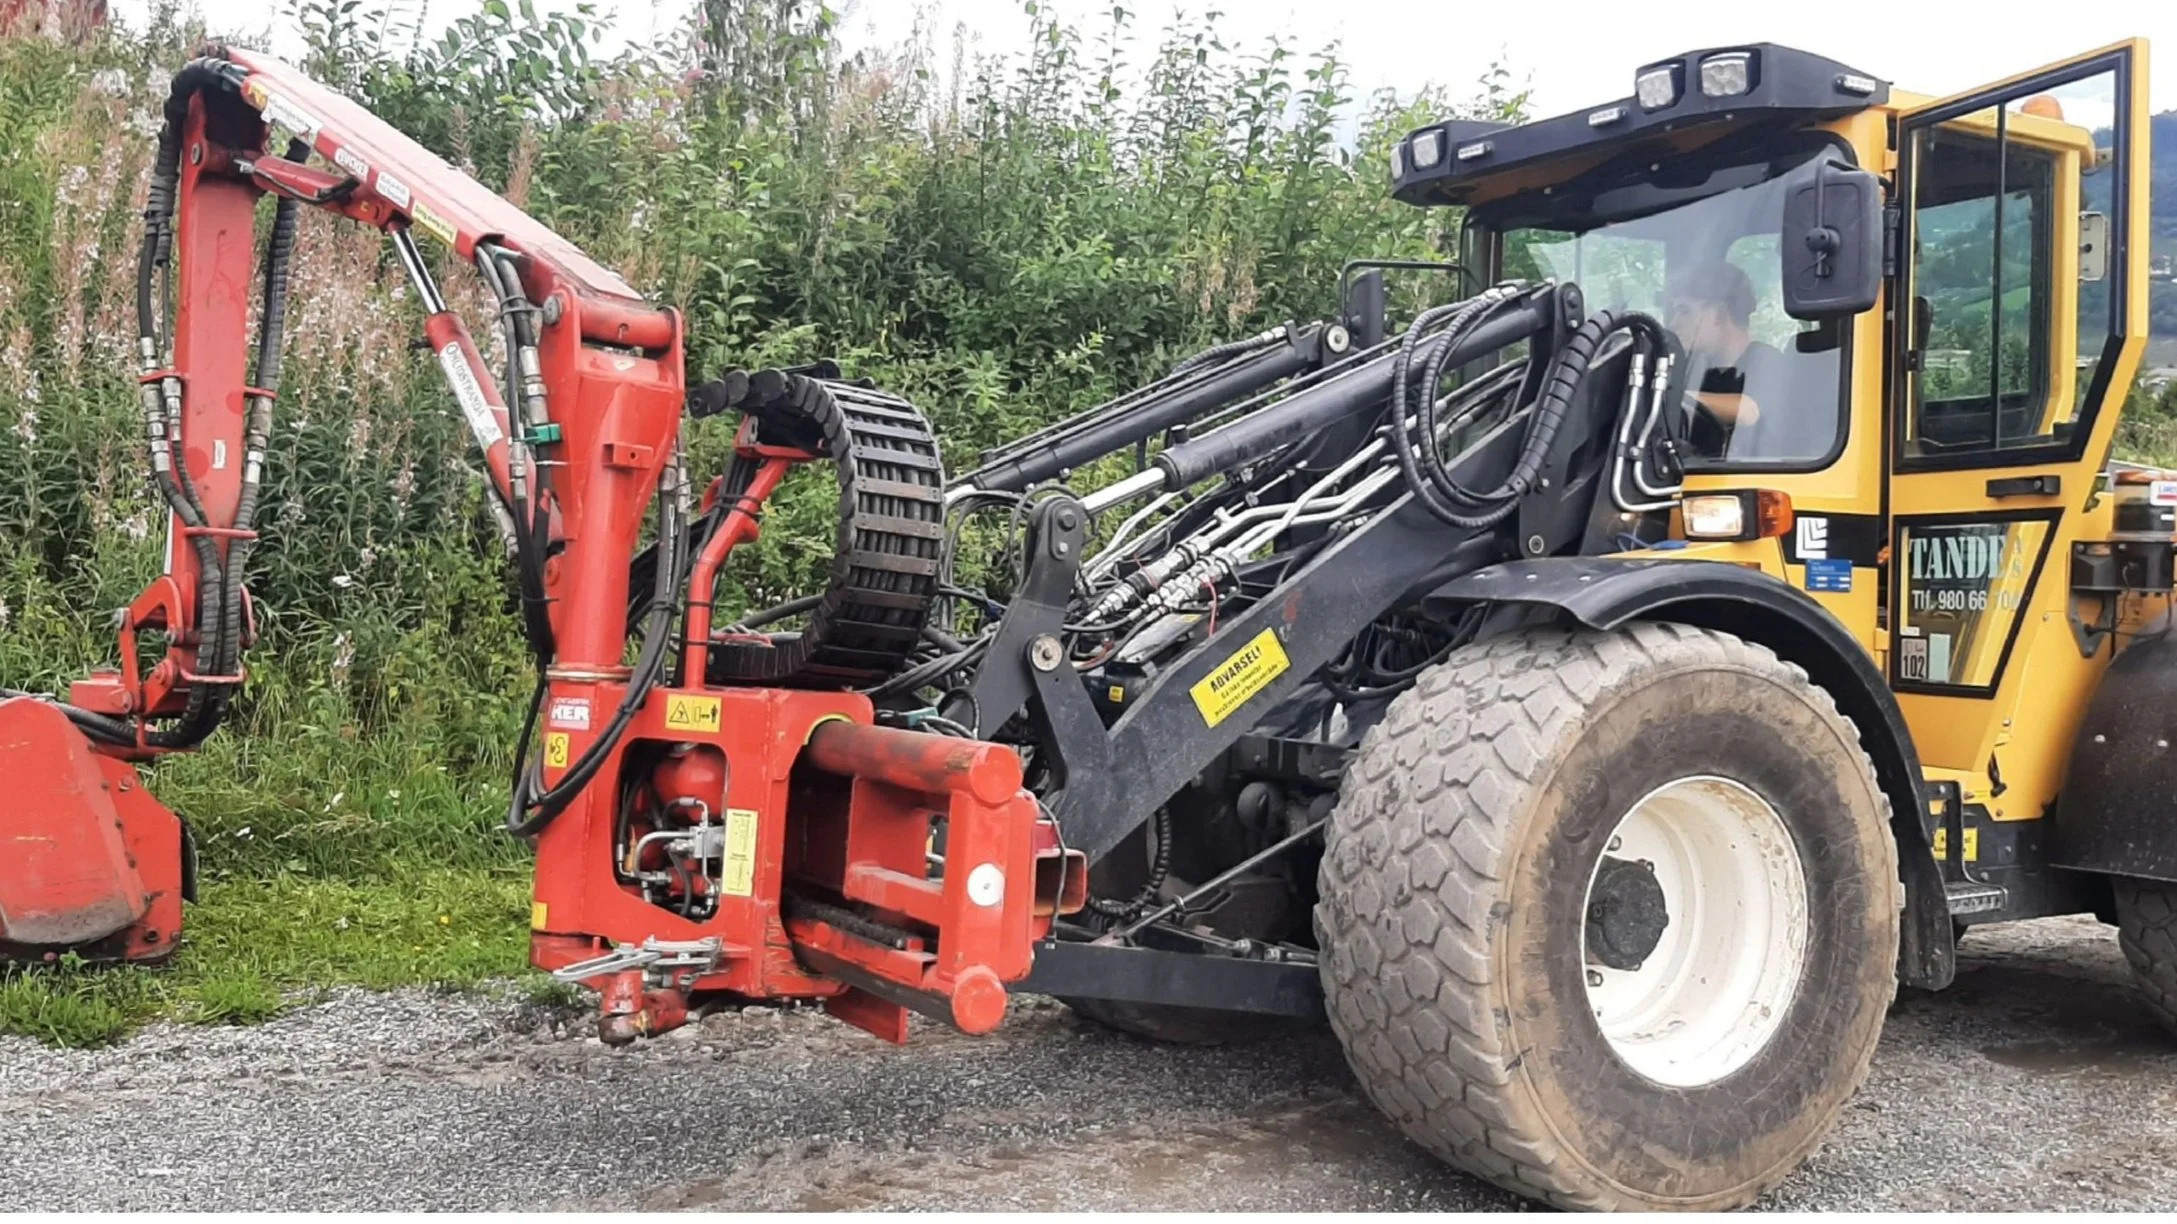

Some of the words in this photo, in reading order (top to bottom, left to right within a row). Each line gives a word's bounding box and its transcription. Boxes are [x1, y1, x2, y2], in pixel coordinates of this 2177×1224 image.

[1938, 590, 1965, 610] 980
[1968, 590, 1988, 610] 66
[1904, 655, 1925, 678] 102
